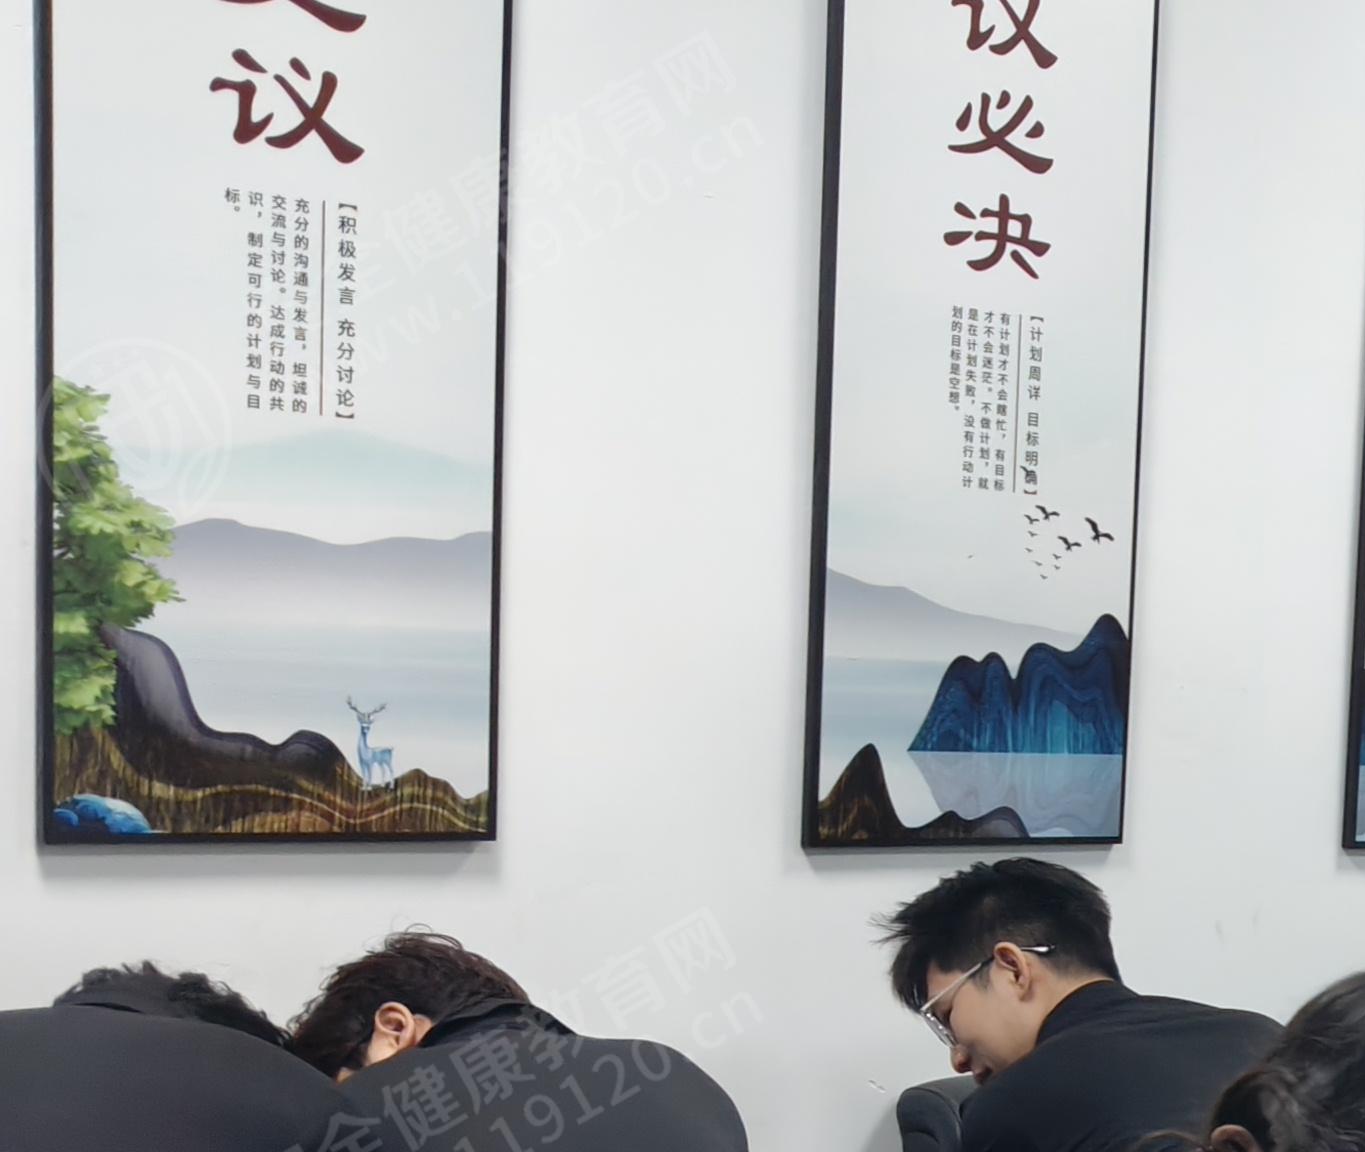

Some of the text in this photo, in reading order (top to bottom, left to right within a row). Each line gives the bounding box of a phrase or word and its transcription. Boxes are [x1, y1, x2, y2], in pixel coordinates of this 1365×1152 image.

[207, 0, 366, 164] 议
[943, 0, 1058, 280] 议必决
[225, 188, 240, 213] 标。
[335, 202, 358, 419] 【积极发言 充分讨论】
[1027, 315, 1044, 401] 【计划周详
